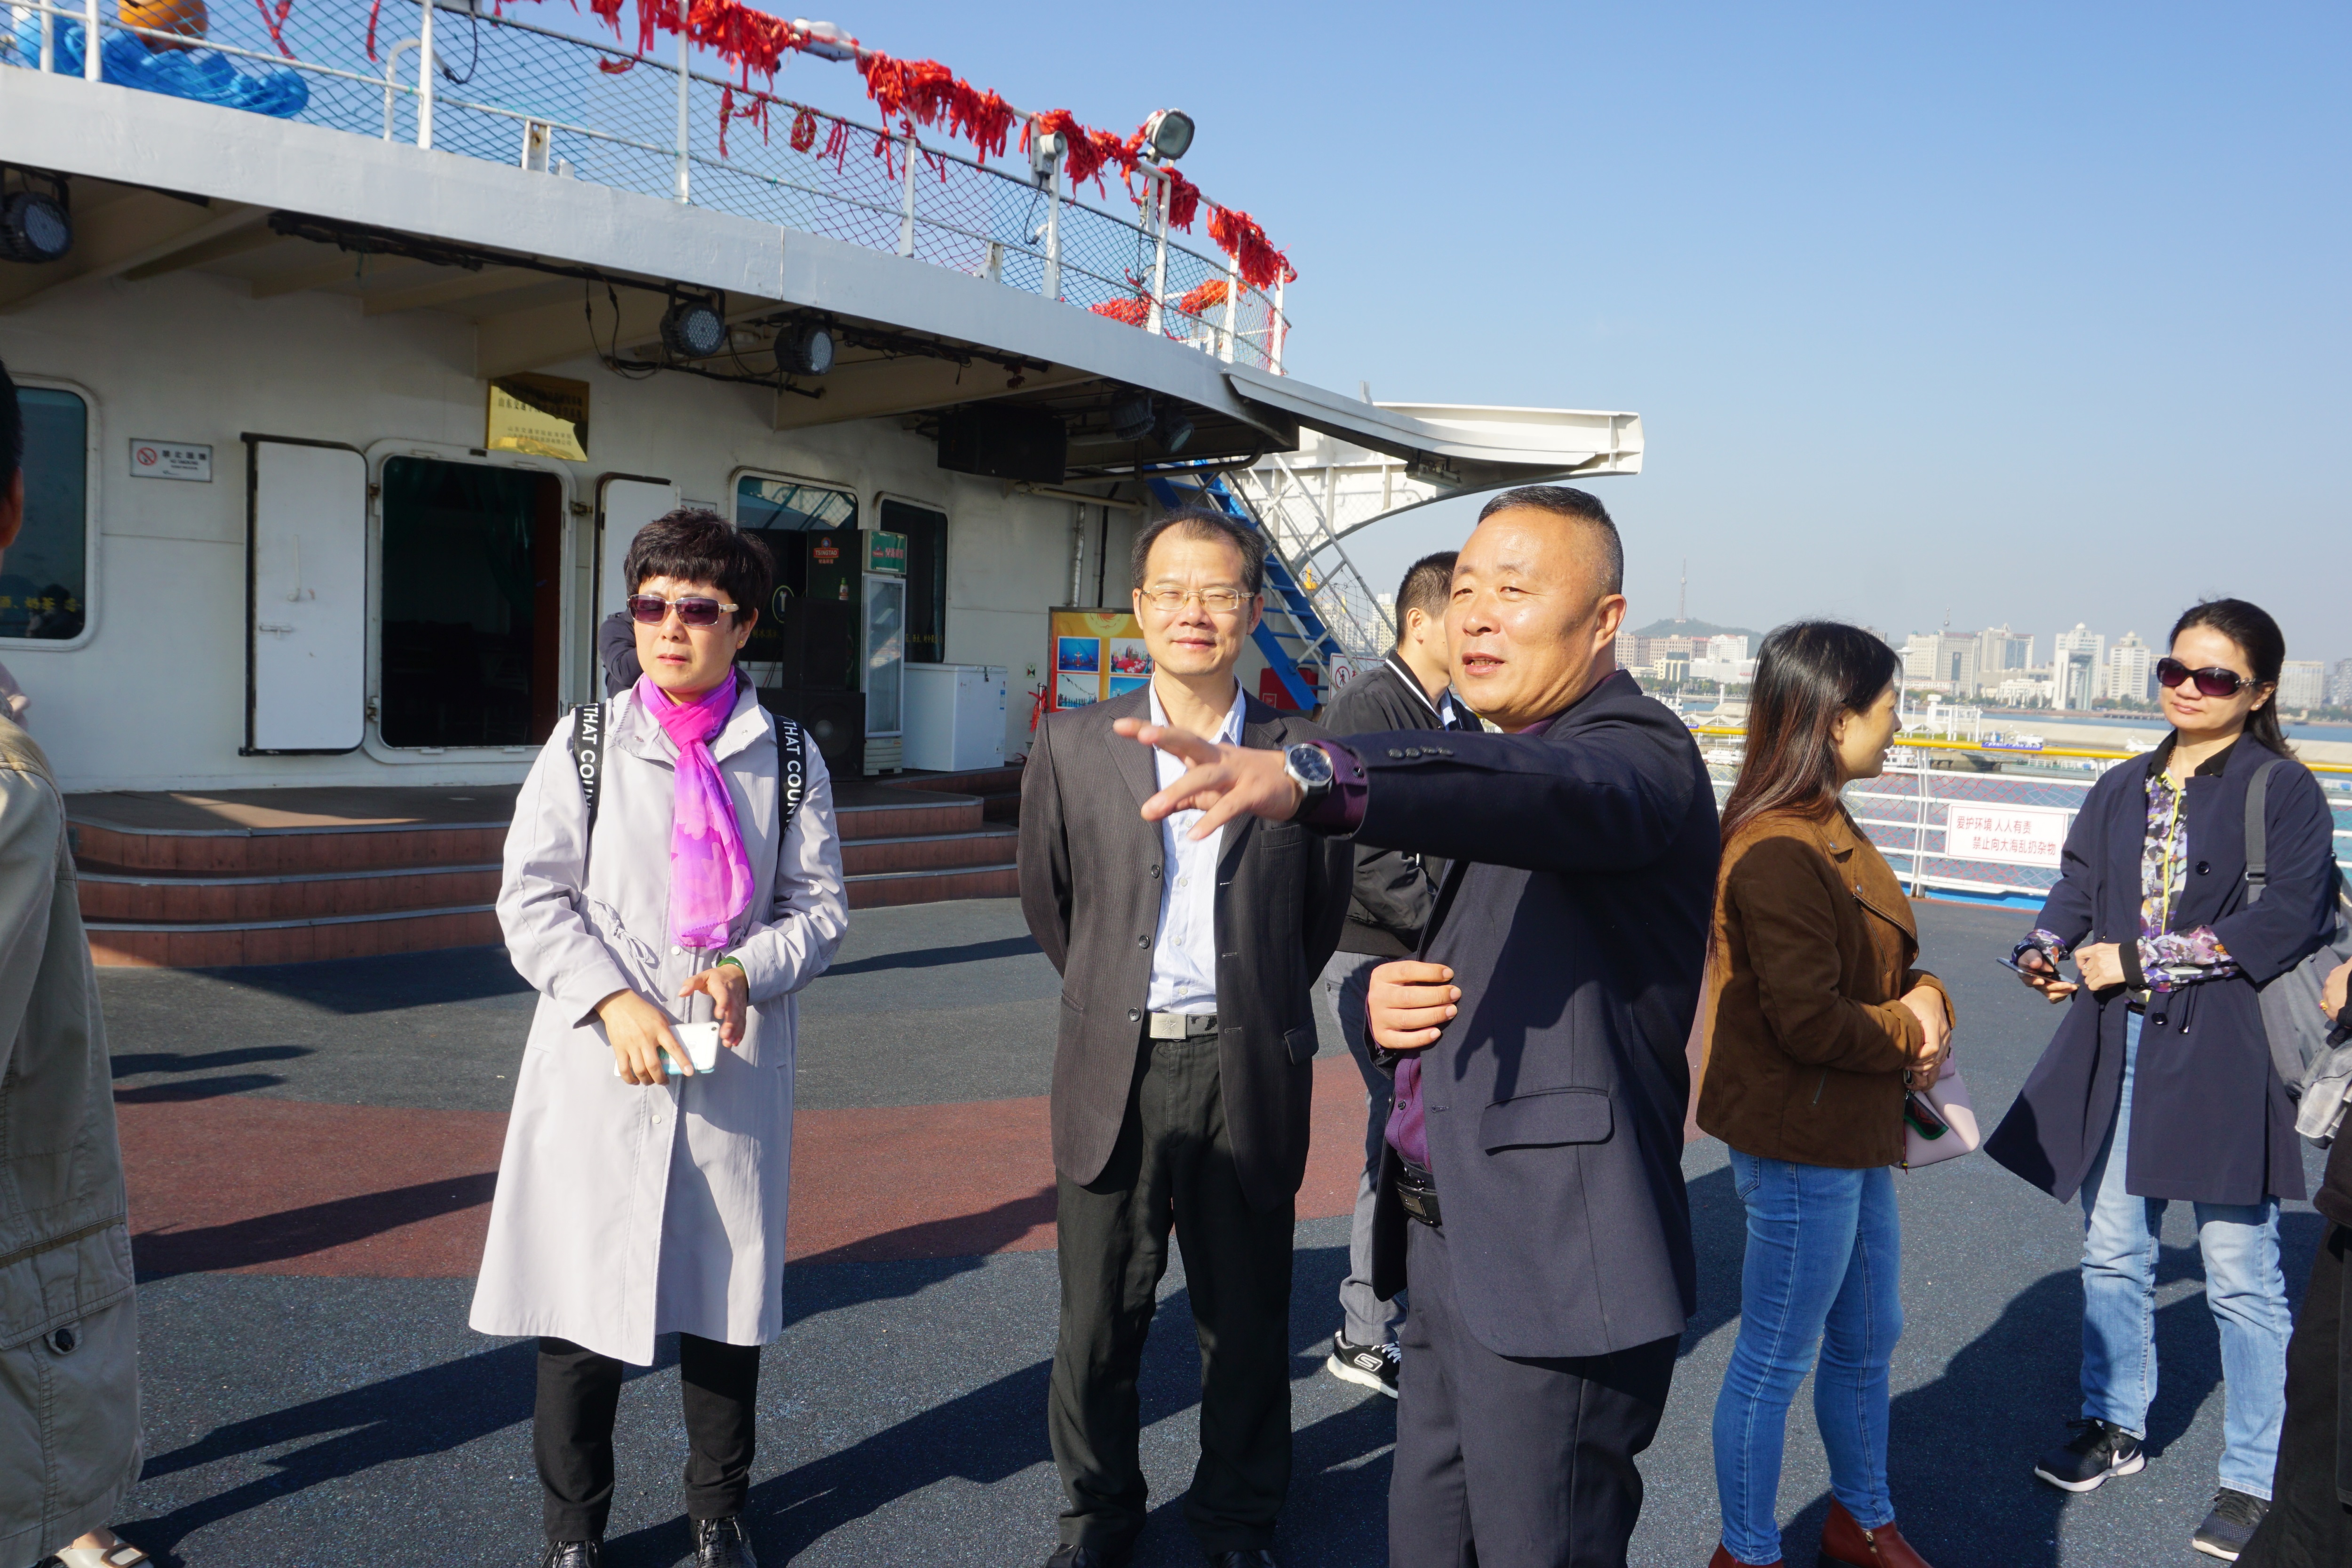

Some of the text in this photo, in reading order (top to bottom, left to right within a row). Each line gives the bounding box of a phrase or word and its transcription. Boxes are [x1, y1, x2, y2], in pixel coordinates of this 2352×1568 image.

[582, 703, 598, 745] THAT
[783, 719, 800, 755] THAT
[1957, 816, 2032, 835] 爱护环境 人人有责
[1973, 836, 2056, 856] 禁止向大海乱扔杂物
